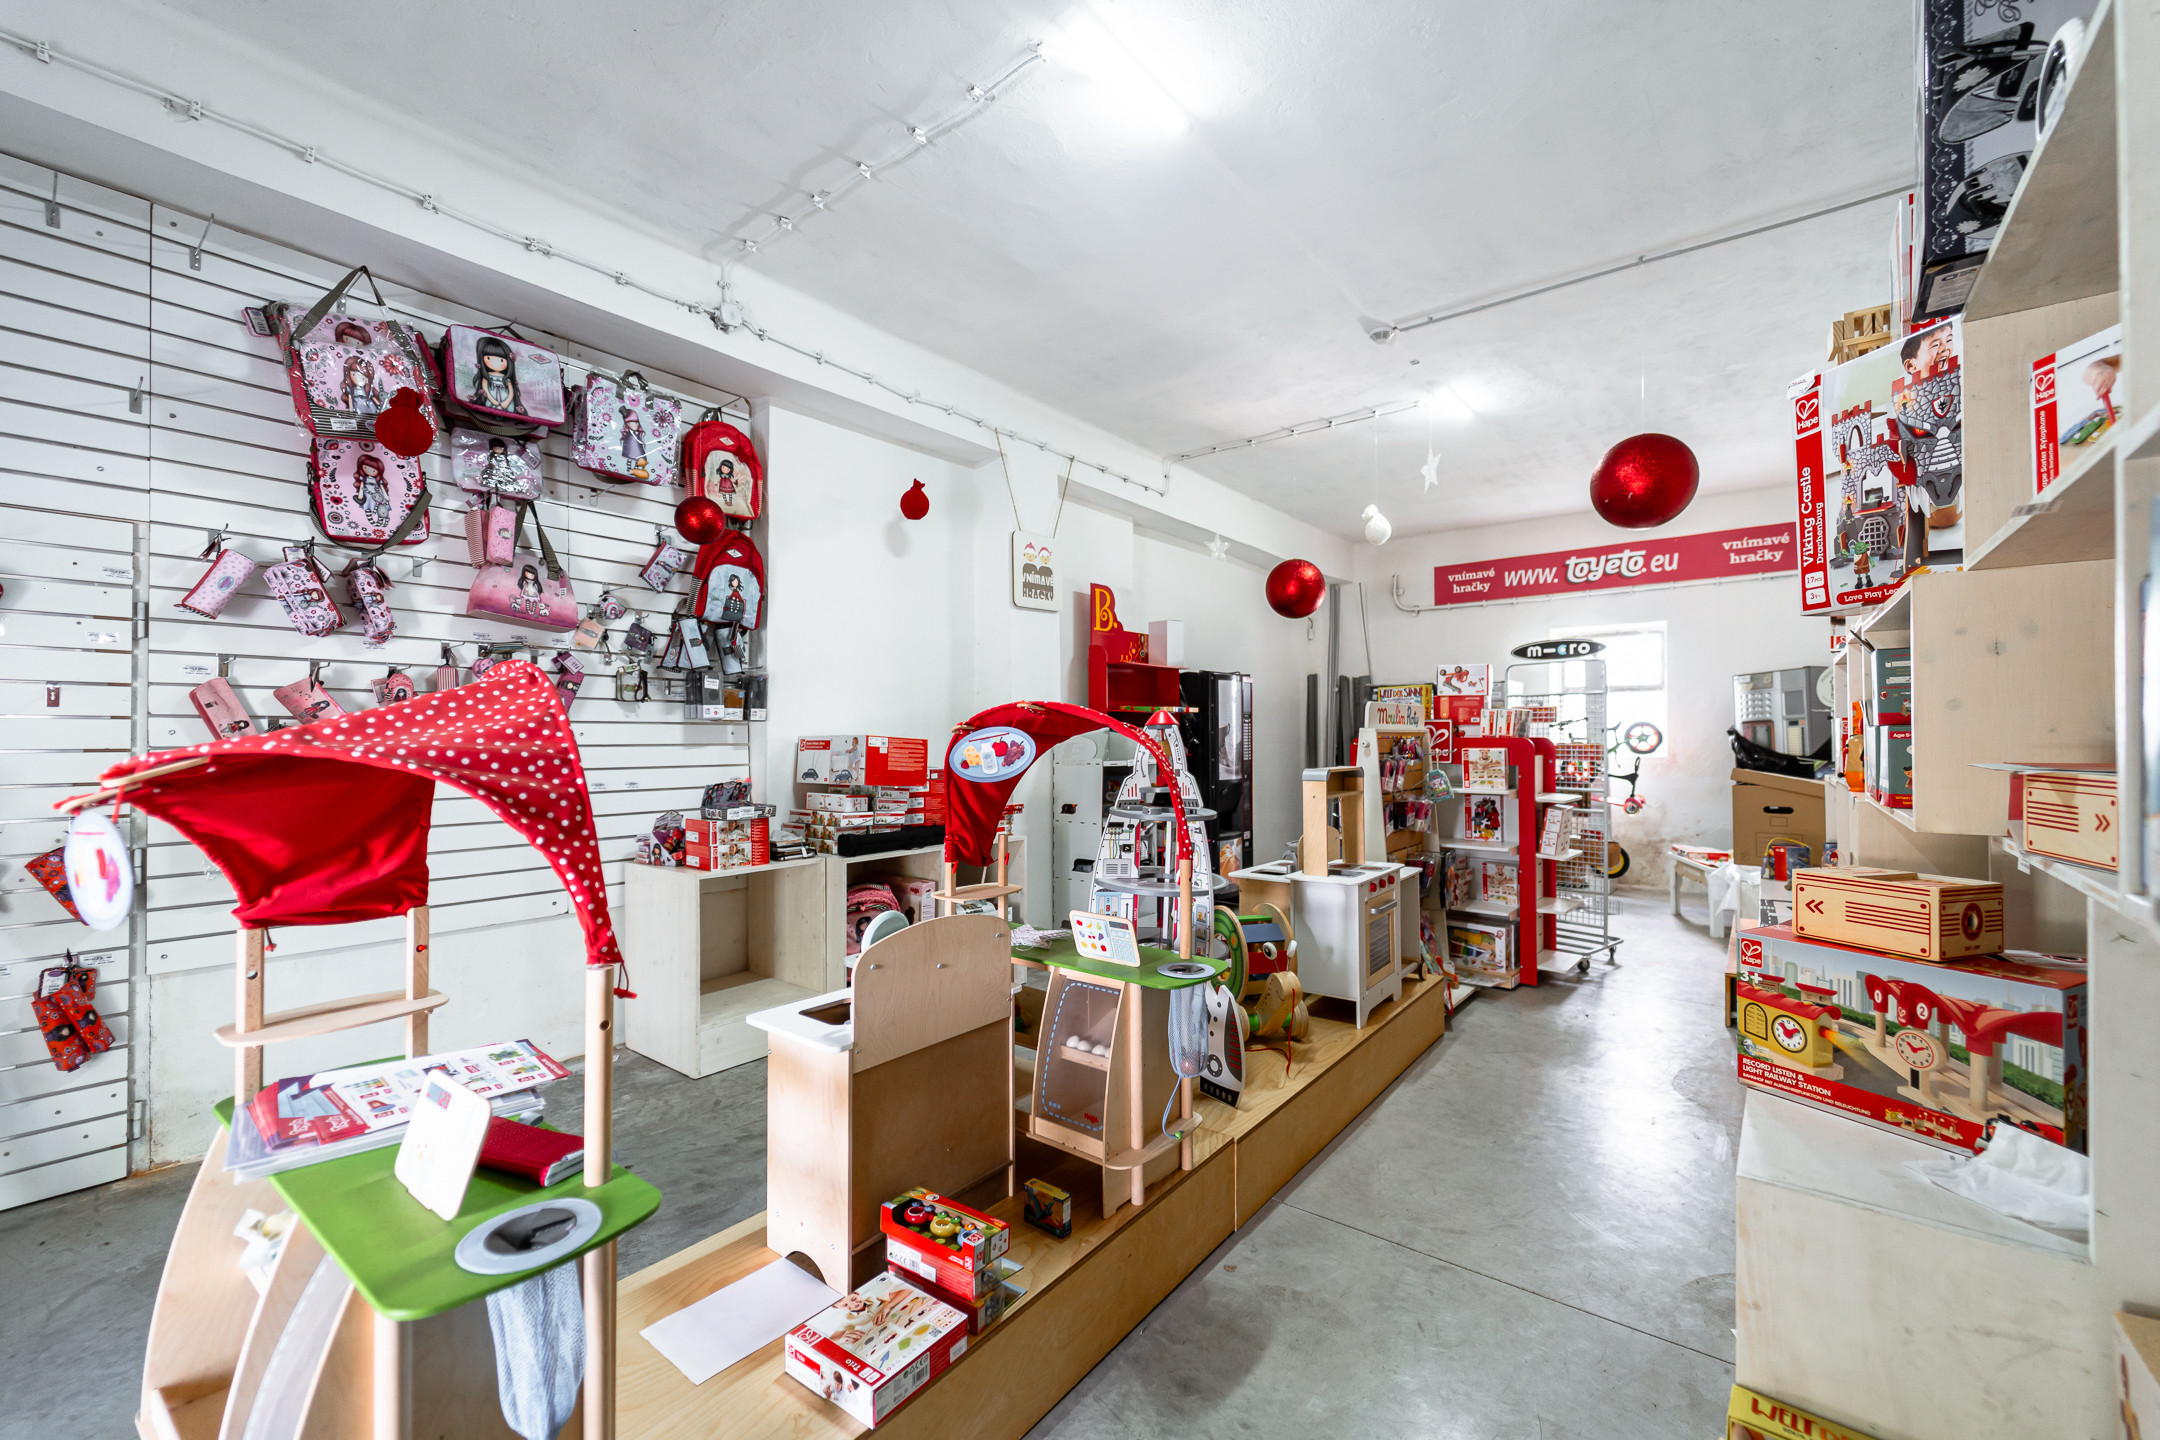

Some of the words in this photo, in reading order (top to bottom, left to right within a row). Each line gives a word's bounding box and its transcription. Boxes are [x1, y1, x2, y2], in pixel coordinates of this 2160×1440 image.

[2036, 388, 2055, 401] Hape
[1797, 415, 1820, 432] Hape
[2039, 410, 2047, 450] Xylophone
[1800, 466, 1812, 514] Castle
[1722, 532, 1790, 551] vnímavé
[1803, 516, 1816, 567] Viking
[1816, 502, 1824, 565] Drachenburg
[1729, 549, 1784, 564] hračky
[1448, 567, 1496, 582] vnímavé
[1452, 581, 1491, 594] hračky
[1844, 592, 1864, 602] Love
[1864, 590, 1884, 600] Play
[1376, 704, 1406, 725] Moulin
[1742, 955, 1762, 965] Hape
[1740, 970, 1763, 984] 3+
[1919, 1006, 1925, 1017] 2
[1742, 1057, 1771, 1071] RECORD
[1772, 1066, 1796, 1079] LISTEN
[1742, 1064, 1763, 1076] LIGHT
[1764, 1071, 1797, 1086] RAILWAY
[1798, 1081, 1831, 1097] STATION
[845, 1358, 861, 1372] Trio
[1751, 1396, 1819, 1437] WELT
